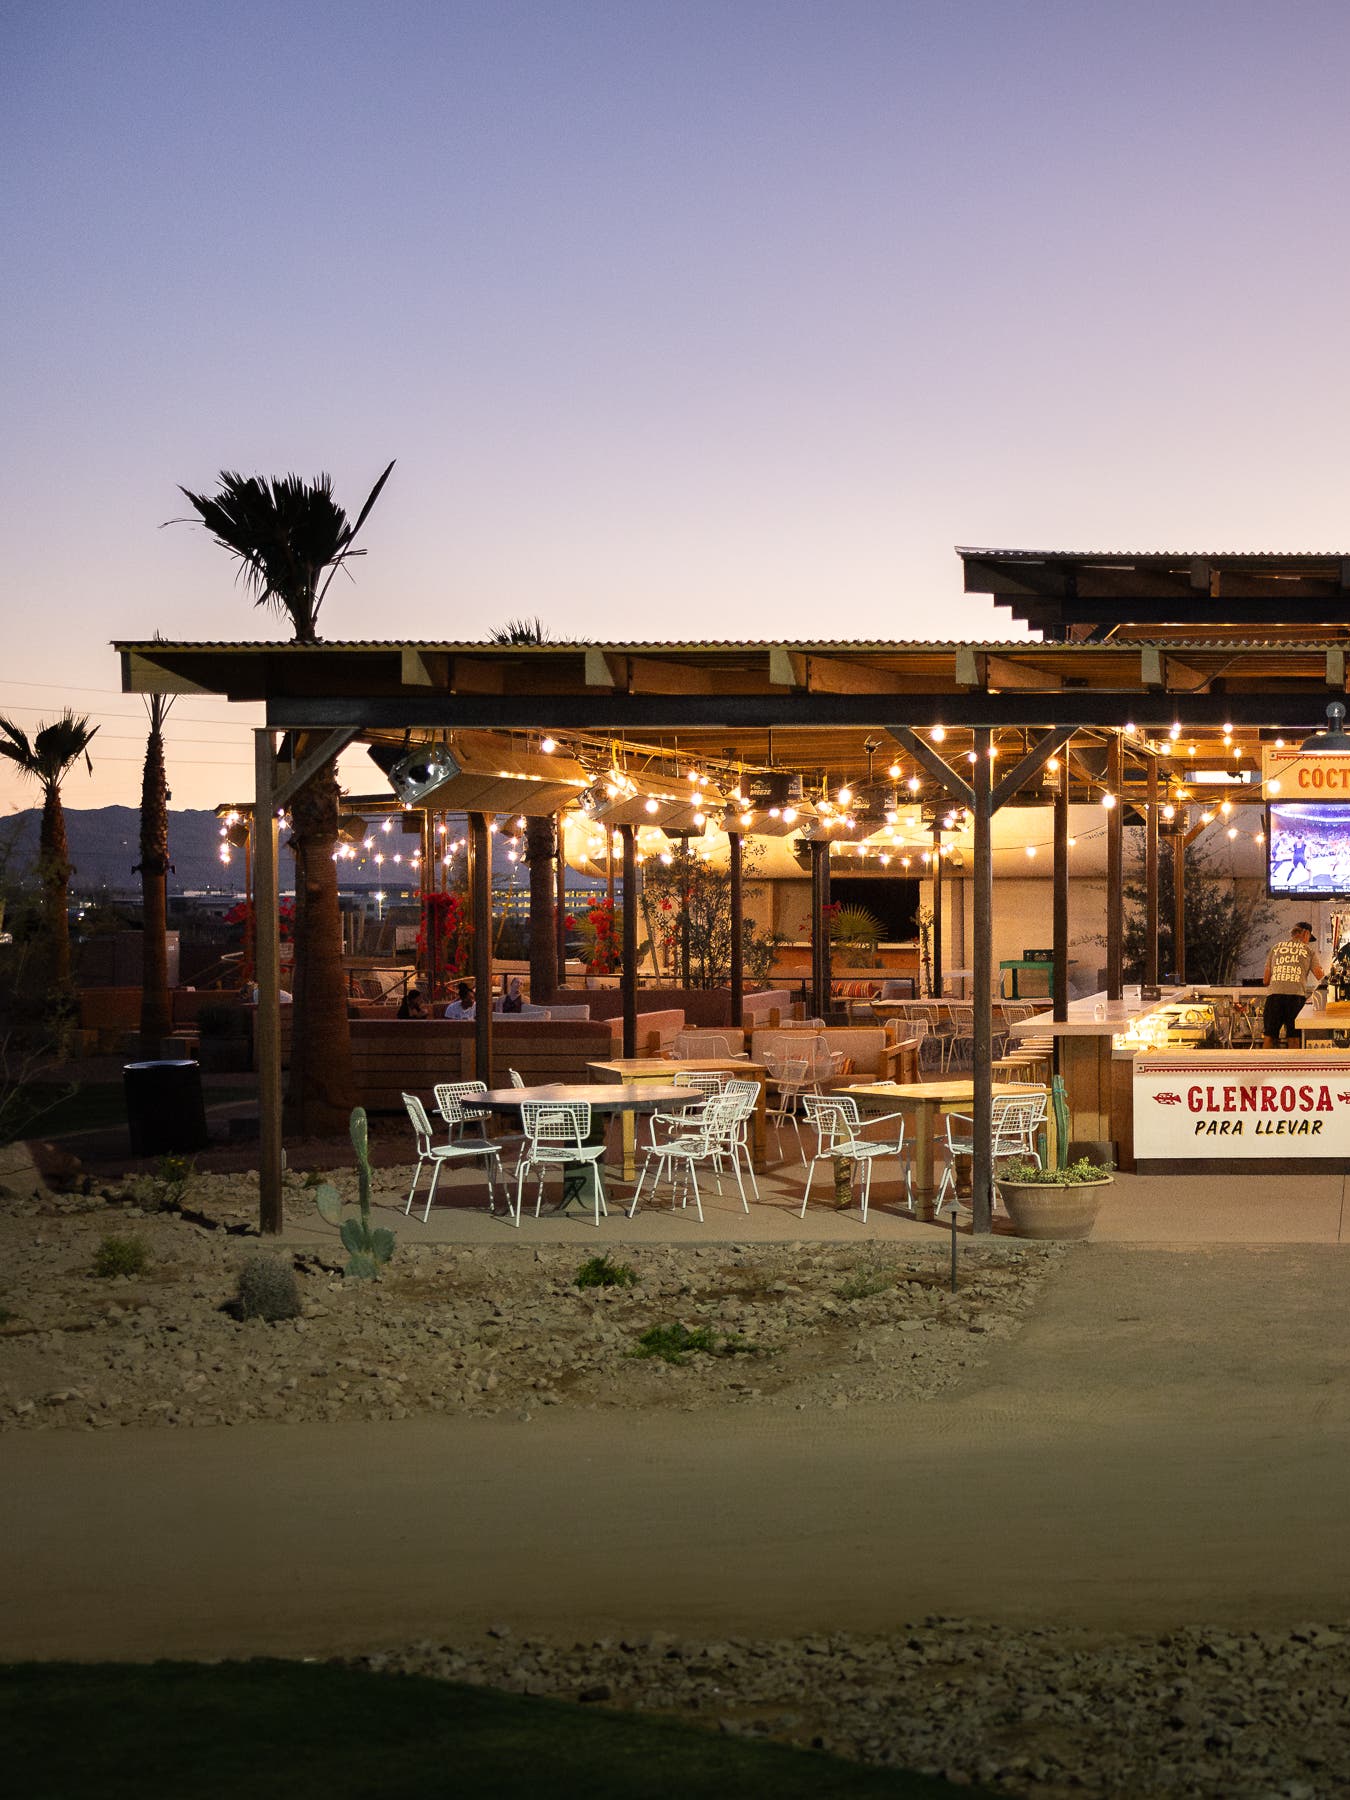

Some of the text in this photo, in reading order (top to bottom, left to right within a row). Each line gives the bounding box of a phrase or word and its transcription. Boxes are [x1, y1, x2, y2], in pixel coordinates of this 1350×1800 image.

[1277, 941, 1305, 949] THANK
[1272, 947, 1308, 957] YOUR
[1275, 955, 1300, 965] LOCAL
[1271, 974, 1301, 982] KEEPER
[1187, 1085, 1334, 1113] GLENROSA
[1194, 1119, 1324, 1137] PARA LLEVAR
